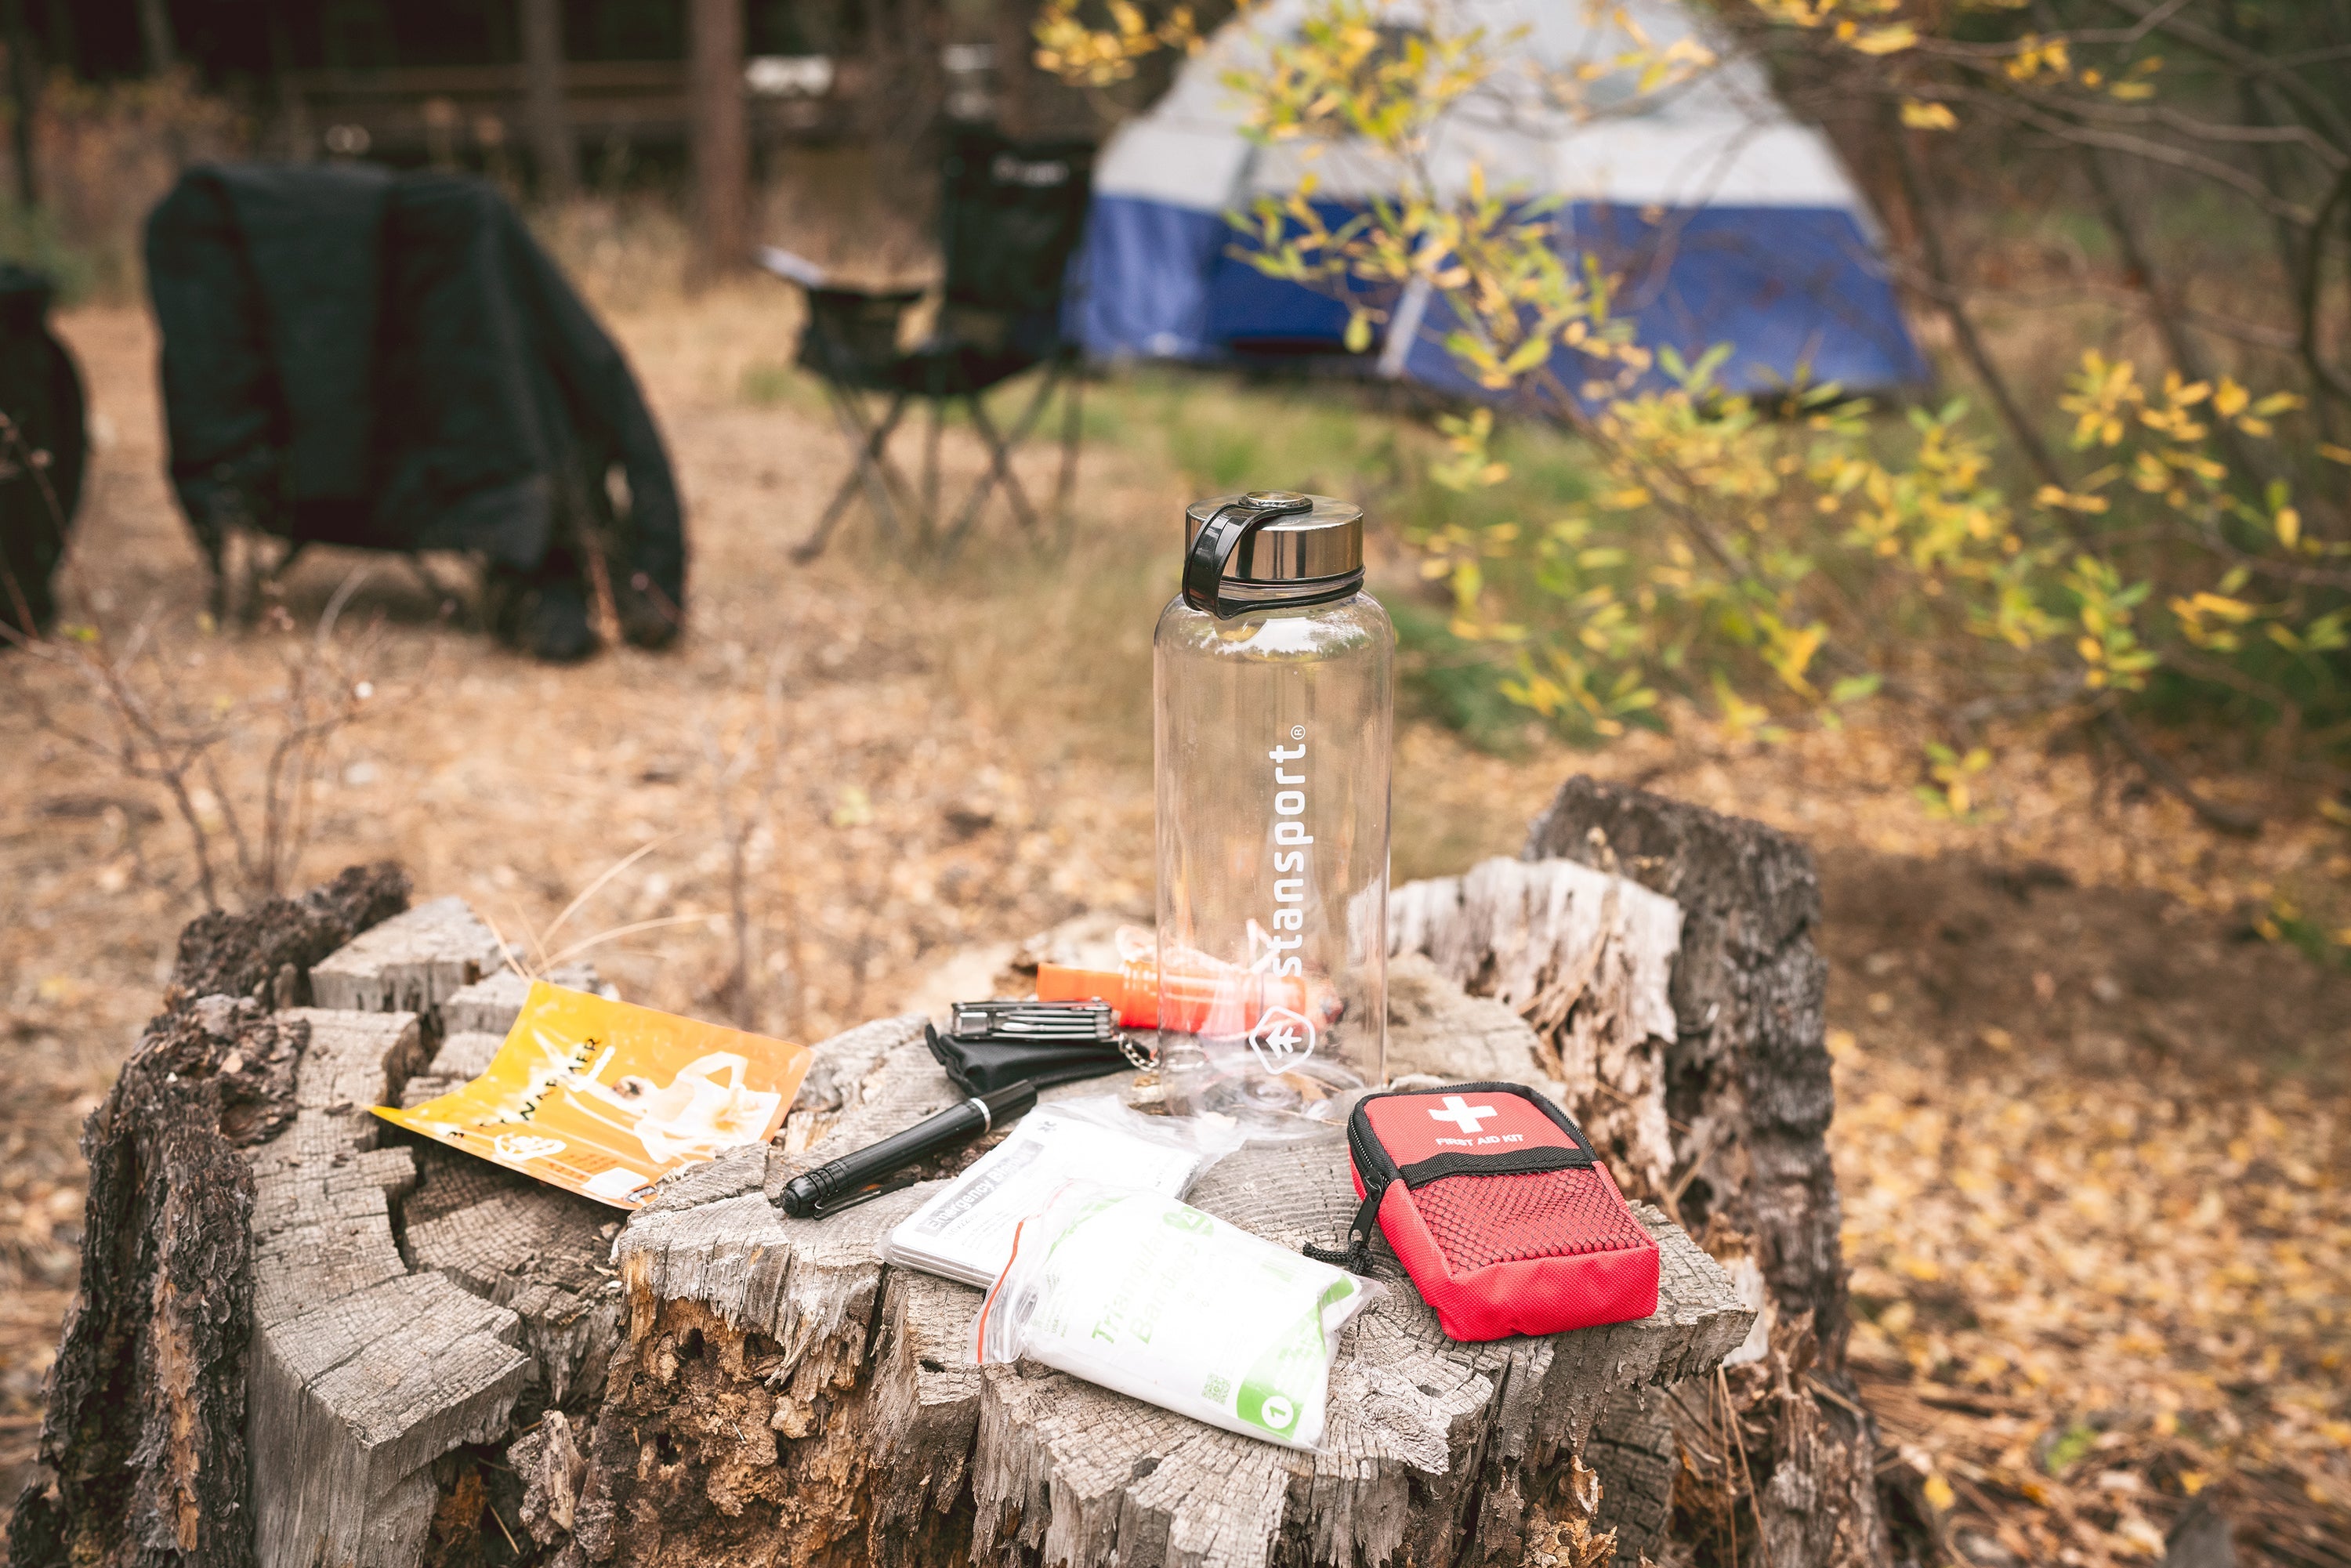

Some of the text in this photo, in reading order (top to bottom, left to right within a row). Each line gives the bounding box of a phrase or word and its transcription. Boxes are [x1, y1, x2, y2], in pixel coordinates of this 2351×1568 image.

[1435, 1134, 1523, 1146] FIRST AID KIT
[925, 1179, 995, 1229] Emergency
[1091, 1224, 1171, 1345] Triangular
[1128, 1241, 1197, 1345] Bandage
[1269, 1405, 1287, 1418] 1
